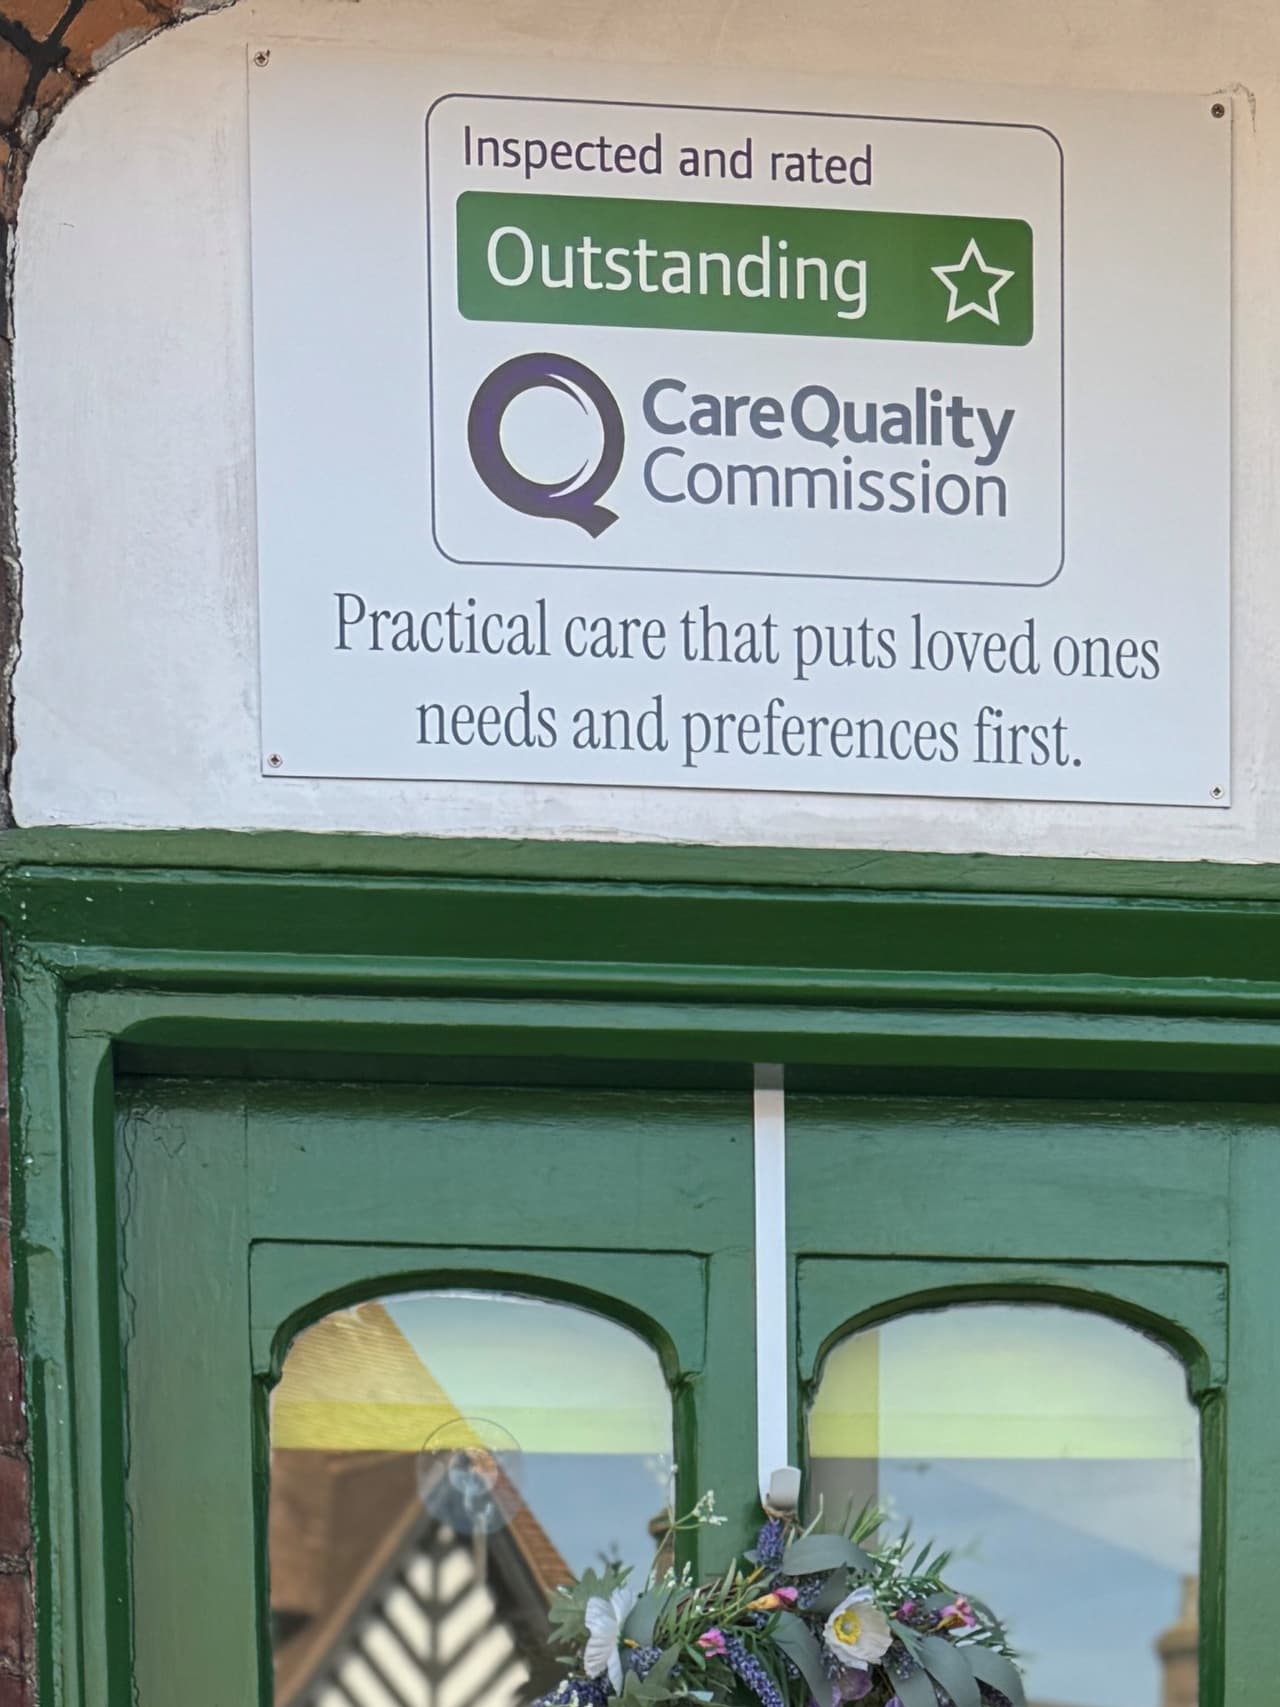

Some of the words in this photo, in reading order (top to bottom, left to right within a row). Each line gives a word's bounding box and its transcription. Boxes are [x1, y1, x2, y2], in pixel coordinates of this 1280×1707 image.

[463, 125, 662, 179] Inspected
[678, 135, 751, 181] and
[769, 143, 874, 186] rated
[487, 225, 868, 320] Outstanding
[644, 446, 1006, 516] Commission
[333, 592, 549, 658] Practical
[564, 615, 666, 663] care
[679, 605, 780, 664] that
[793, 613, 896, 679] puts
[909, 613, 1040, 677] loved
[1052, 632, 1160, 682] ones
[416, 692, 558, 750] needs
[572, 696, 668, 754] and
[681, 698, 958, 768] preferences
[971, 708, 1082, 768] first.
